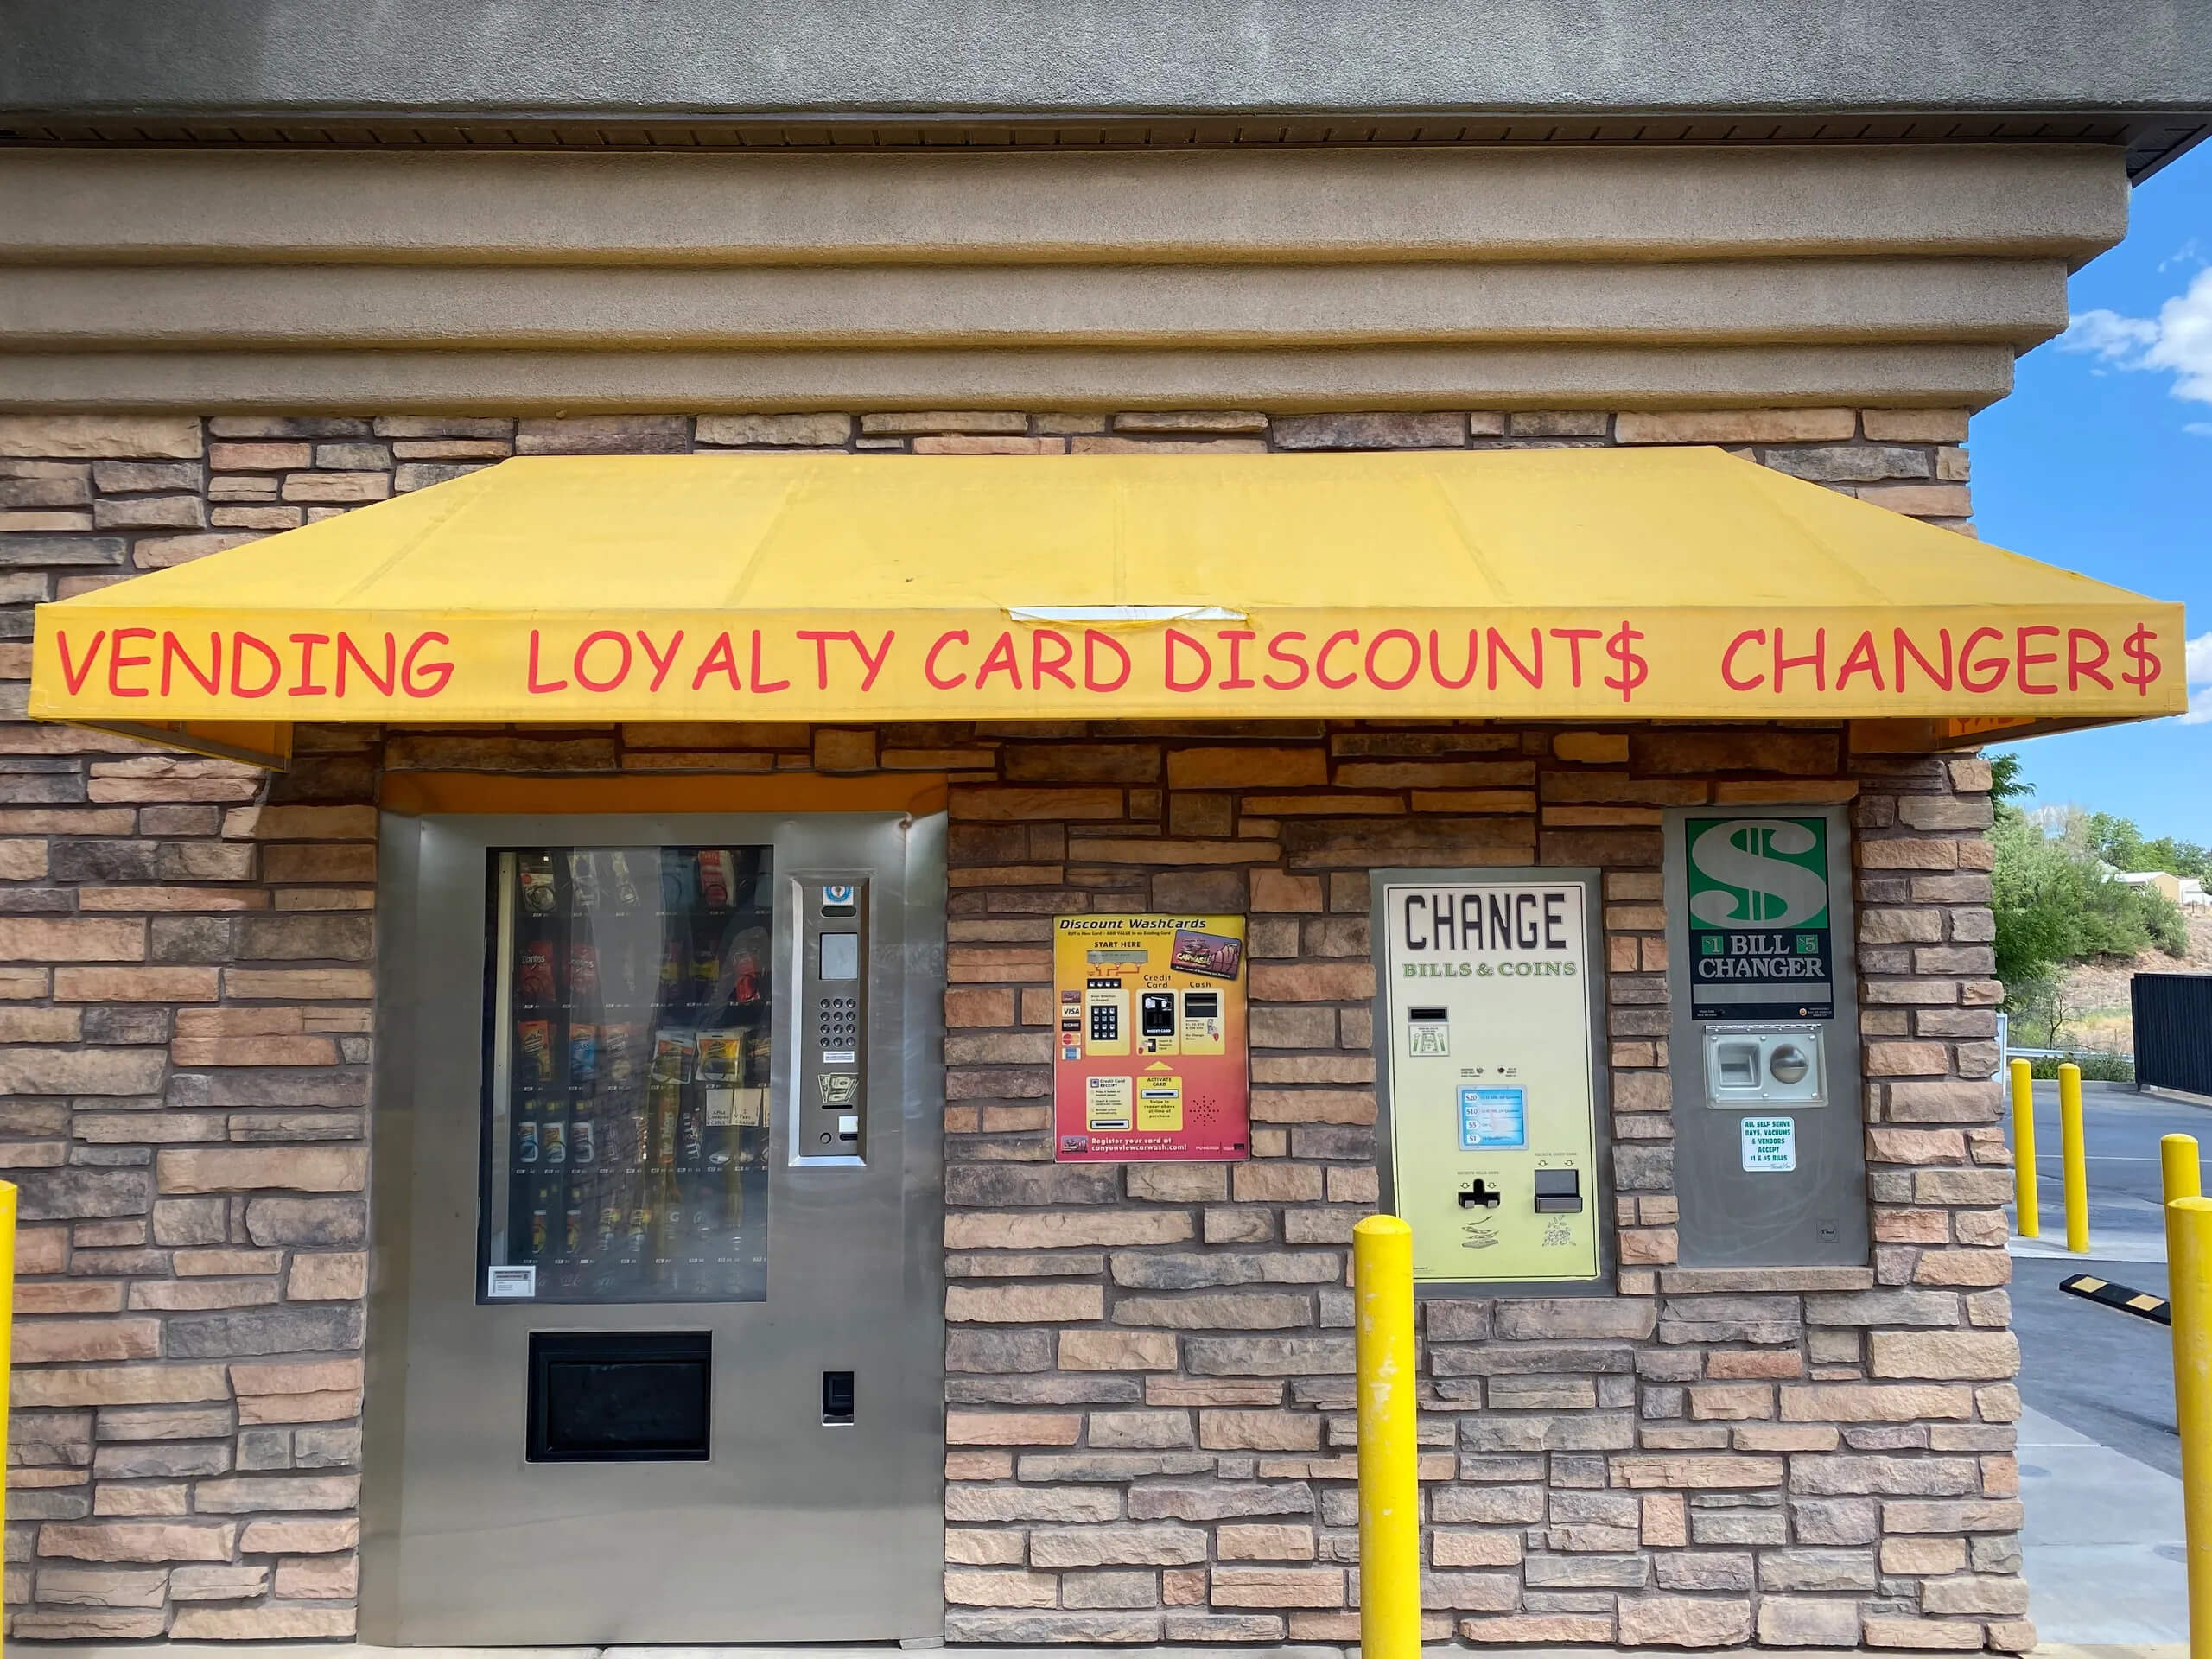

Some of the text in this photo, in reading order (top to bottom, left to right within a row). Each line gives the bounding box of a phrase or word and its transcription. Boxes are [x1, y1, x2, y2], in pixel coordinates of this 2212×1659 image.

[57, 620, 2163, 702] VENDING LOYALTY CARD DISCOUNT$ CHANGER$
[1059, 918, 1206, 930] Discount WashCards
[1404, 893, 1567, 950] CHANGE
[1730, 934, 1790, 955] BILL
[1402, 961, 1577, 977] BILLS & COINS
[1698, 957, 1825, 978] CHANGER
[1091, 1143, 1187, 1152] canyonviewcarwash.com!
